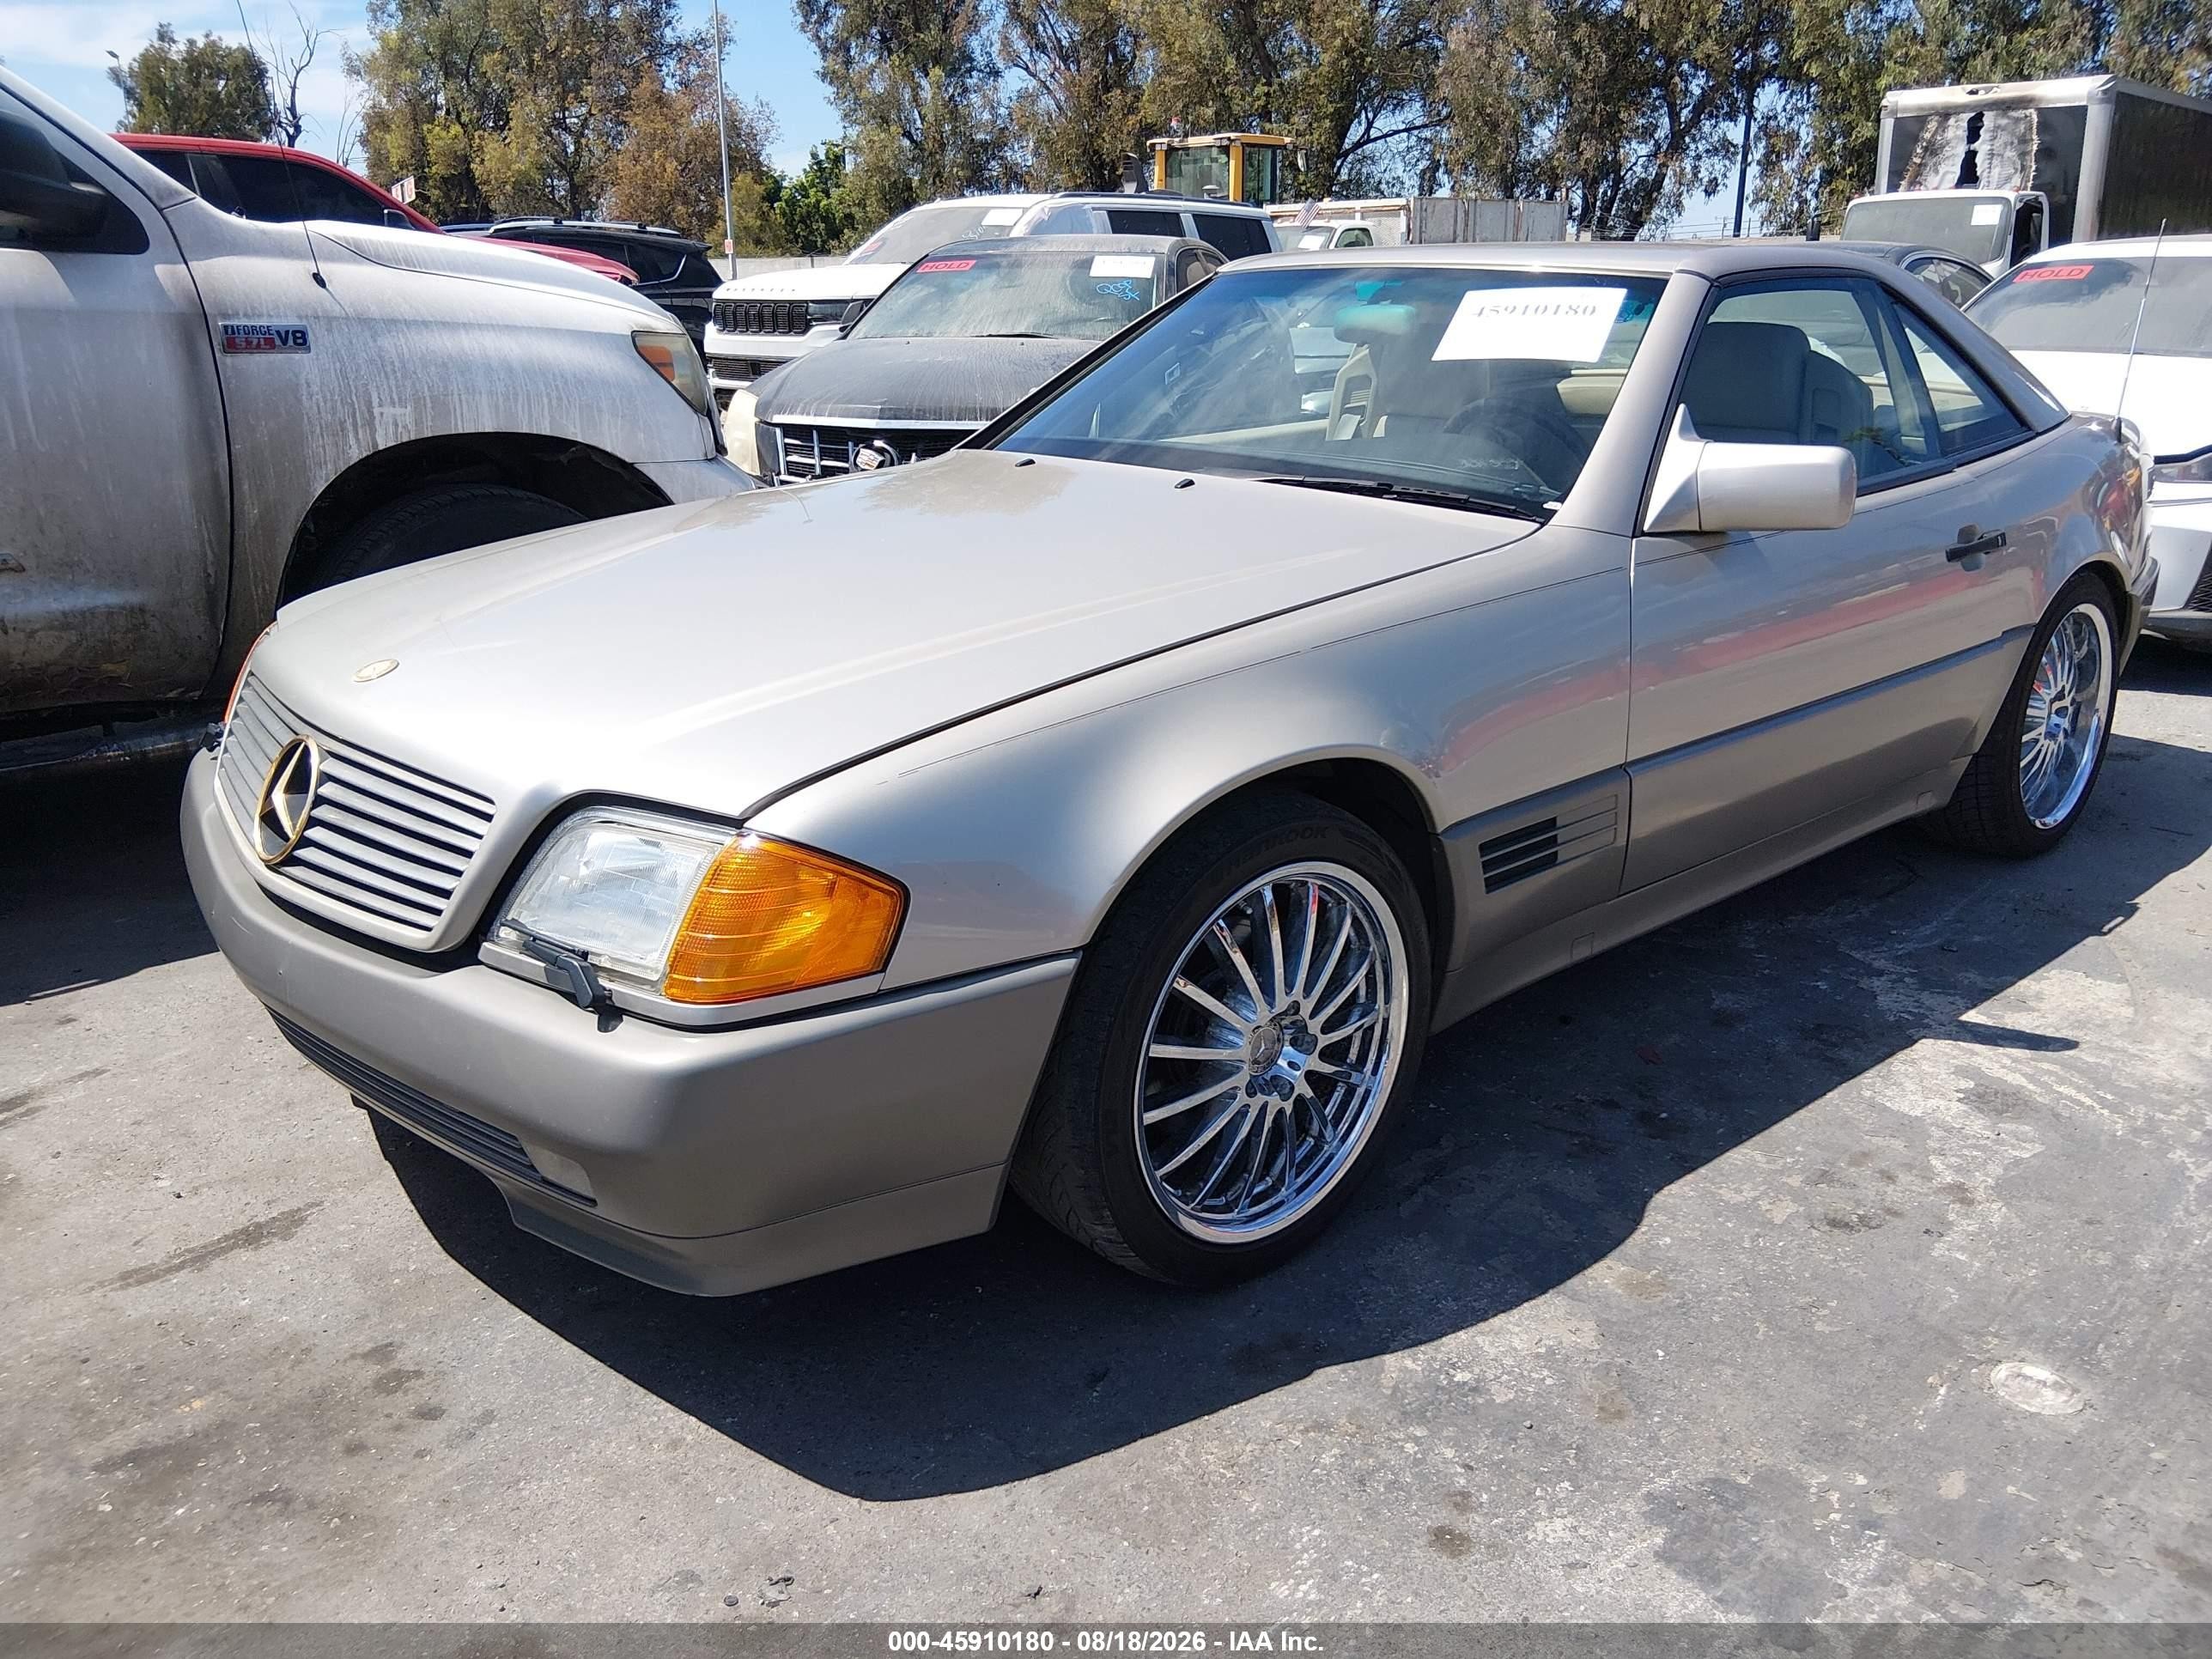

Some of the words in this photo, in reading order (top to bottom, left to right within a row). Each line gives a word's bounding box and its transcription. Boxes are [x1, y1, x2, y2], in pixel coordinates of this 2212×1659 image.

[920, 261, 970, 271] HOLD
[2020, 268, 2084, 279] HOLD
[1471, 303, 1598, 319] 45910180
[275, 329, 308, 347] V8
